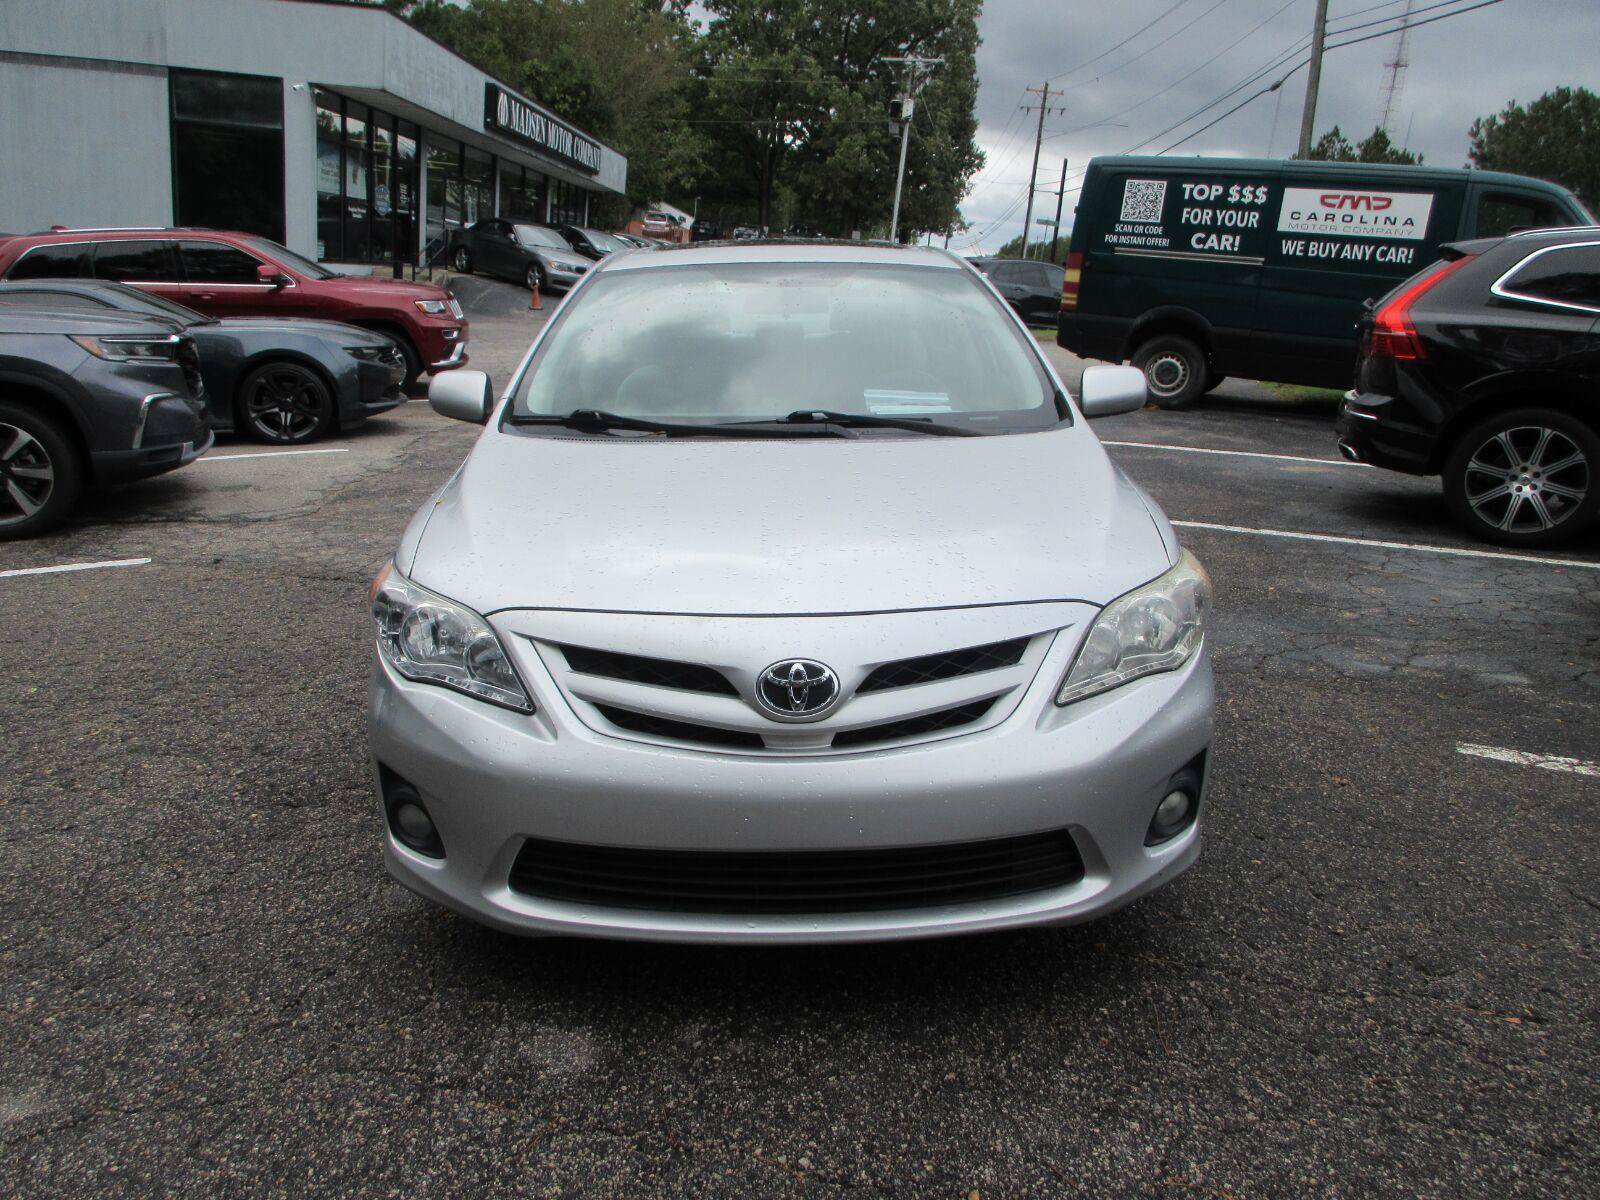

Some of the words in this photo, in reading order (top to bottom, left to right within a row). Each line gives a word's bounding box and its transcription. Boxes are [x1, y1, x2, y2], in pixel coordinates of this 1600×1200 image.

[511, 100, 546, 143] MADSEN
[547, 121, 573, 157] MOTOR
[574, 136, 600, 170] COMPANY
[1182, 184, 1223, 200] TOP
[1227, 184, 1268, 204] $$$
[1182, 208, 1212, 225] FOR
[1216, 209, 1259, 228] YOUR
[1290, 211, 1415, 227] CAROLINA
[1115, 224, 1133, 232] SCAN
[1145, 226, 1163, 234] CODE
[1287, 222, 1337, 232] MOTOR
[1342, 226, 1416, 236] COMPANY
[1105, 234, 1118, 243] FOR
[1119, 235, 1146, 245] INSTANT
[1146, 237, 1170, 247] OFFER!
[1191, 232, 1240, 251] CAR!
[1282, 239, 1304, 256] WE
[1308, 241, 1340, 258] BUY
[1340, 244, 1375, 261] ANY
[1376, 246, 1415, 264] CAR!
